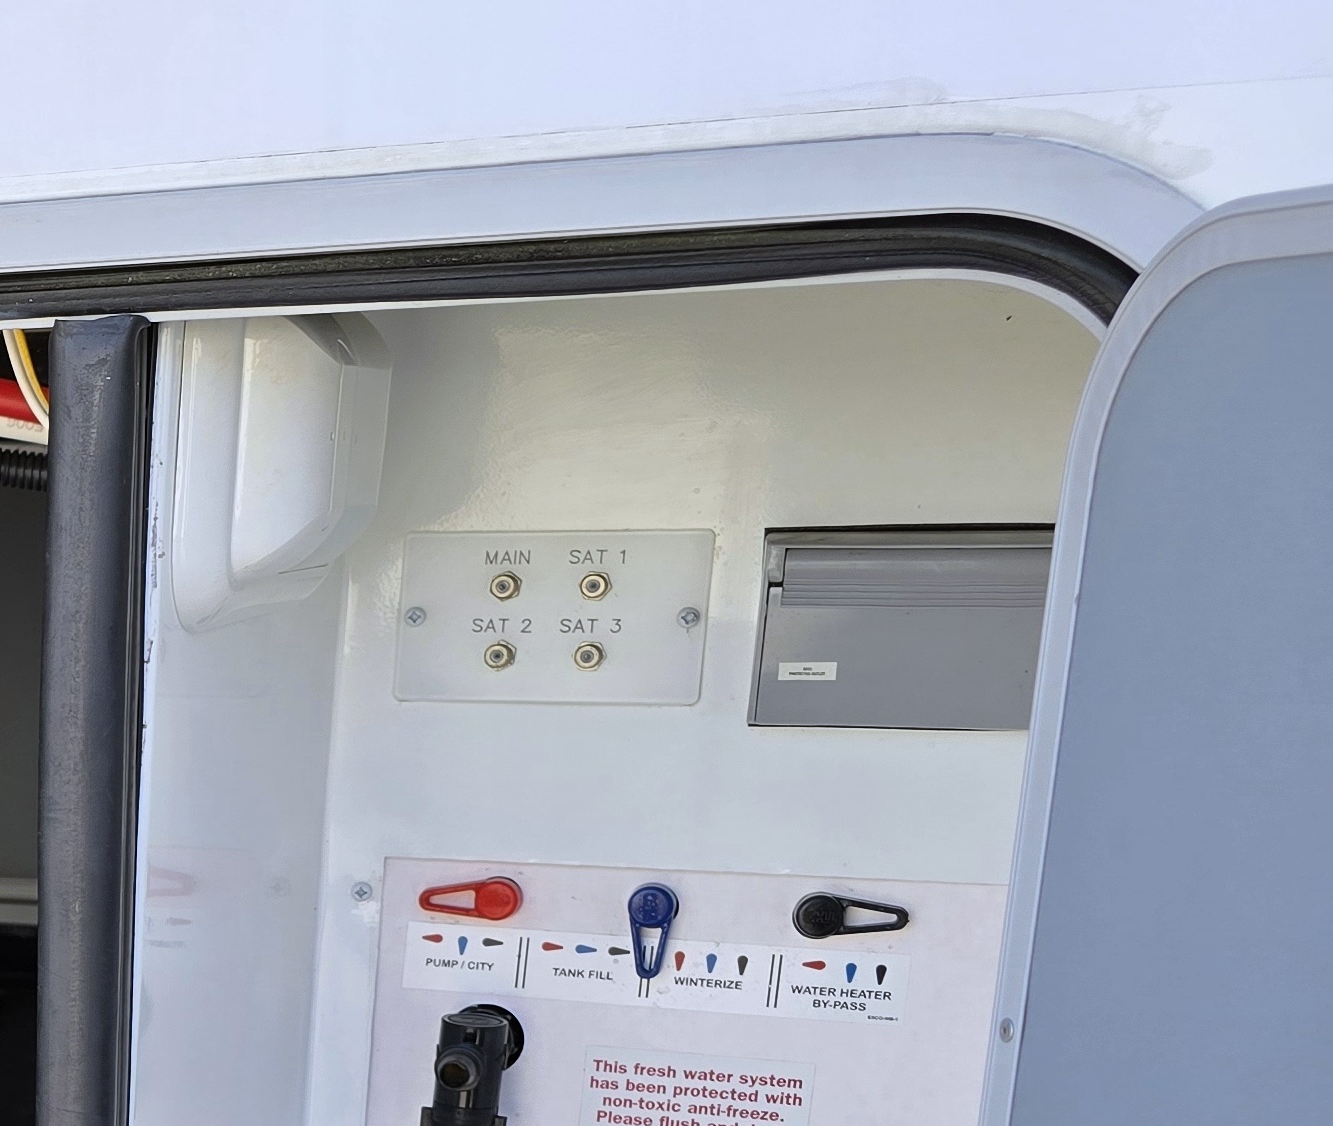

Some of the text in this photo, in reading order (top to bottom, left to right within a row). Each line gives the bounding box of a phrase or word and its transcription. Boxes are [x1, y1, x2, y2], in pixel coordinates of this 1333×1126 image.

[485, 550, 531, 565] MAIN
[569, 549, 627, 564] SAT 1
[471, 618, 532, 634] SAT 2
[559, 618, 622, 634] SAT 3
[425, 958, 459, 968] PUMP
[467, 961, 495, 971] CITY
[552, 967, 613, 980] TANK FILL
[673, 976, 743, 990] WINTERIZE
[791, 984, 892, 1000] WATER HEATER
[813, 999, 867, 1011] BY-PASS
[593, 1059, 803, 1090] This fresh water system
[589, 1076, 803, 1106] has been protected with
[603, 1096, 785, 1122] non-toxic anti-freeze.
[596, 1110, 653, 1126] Please
